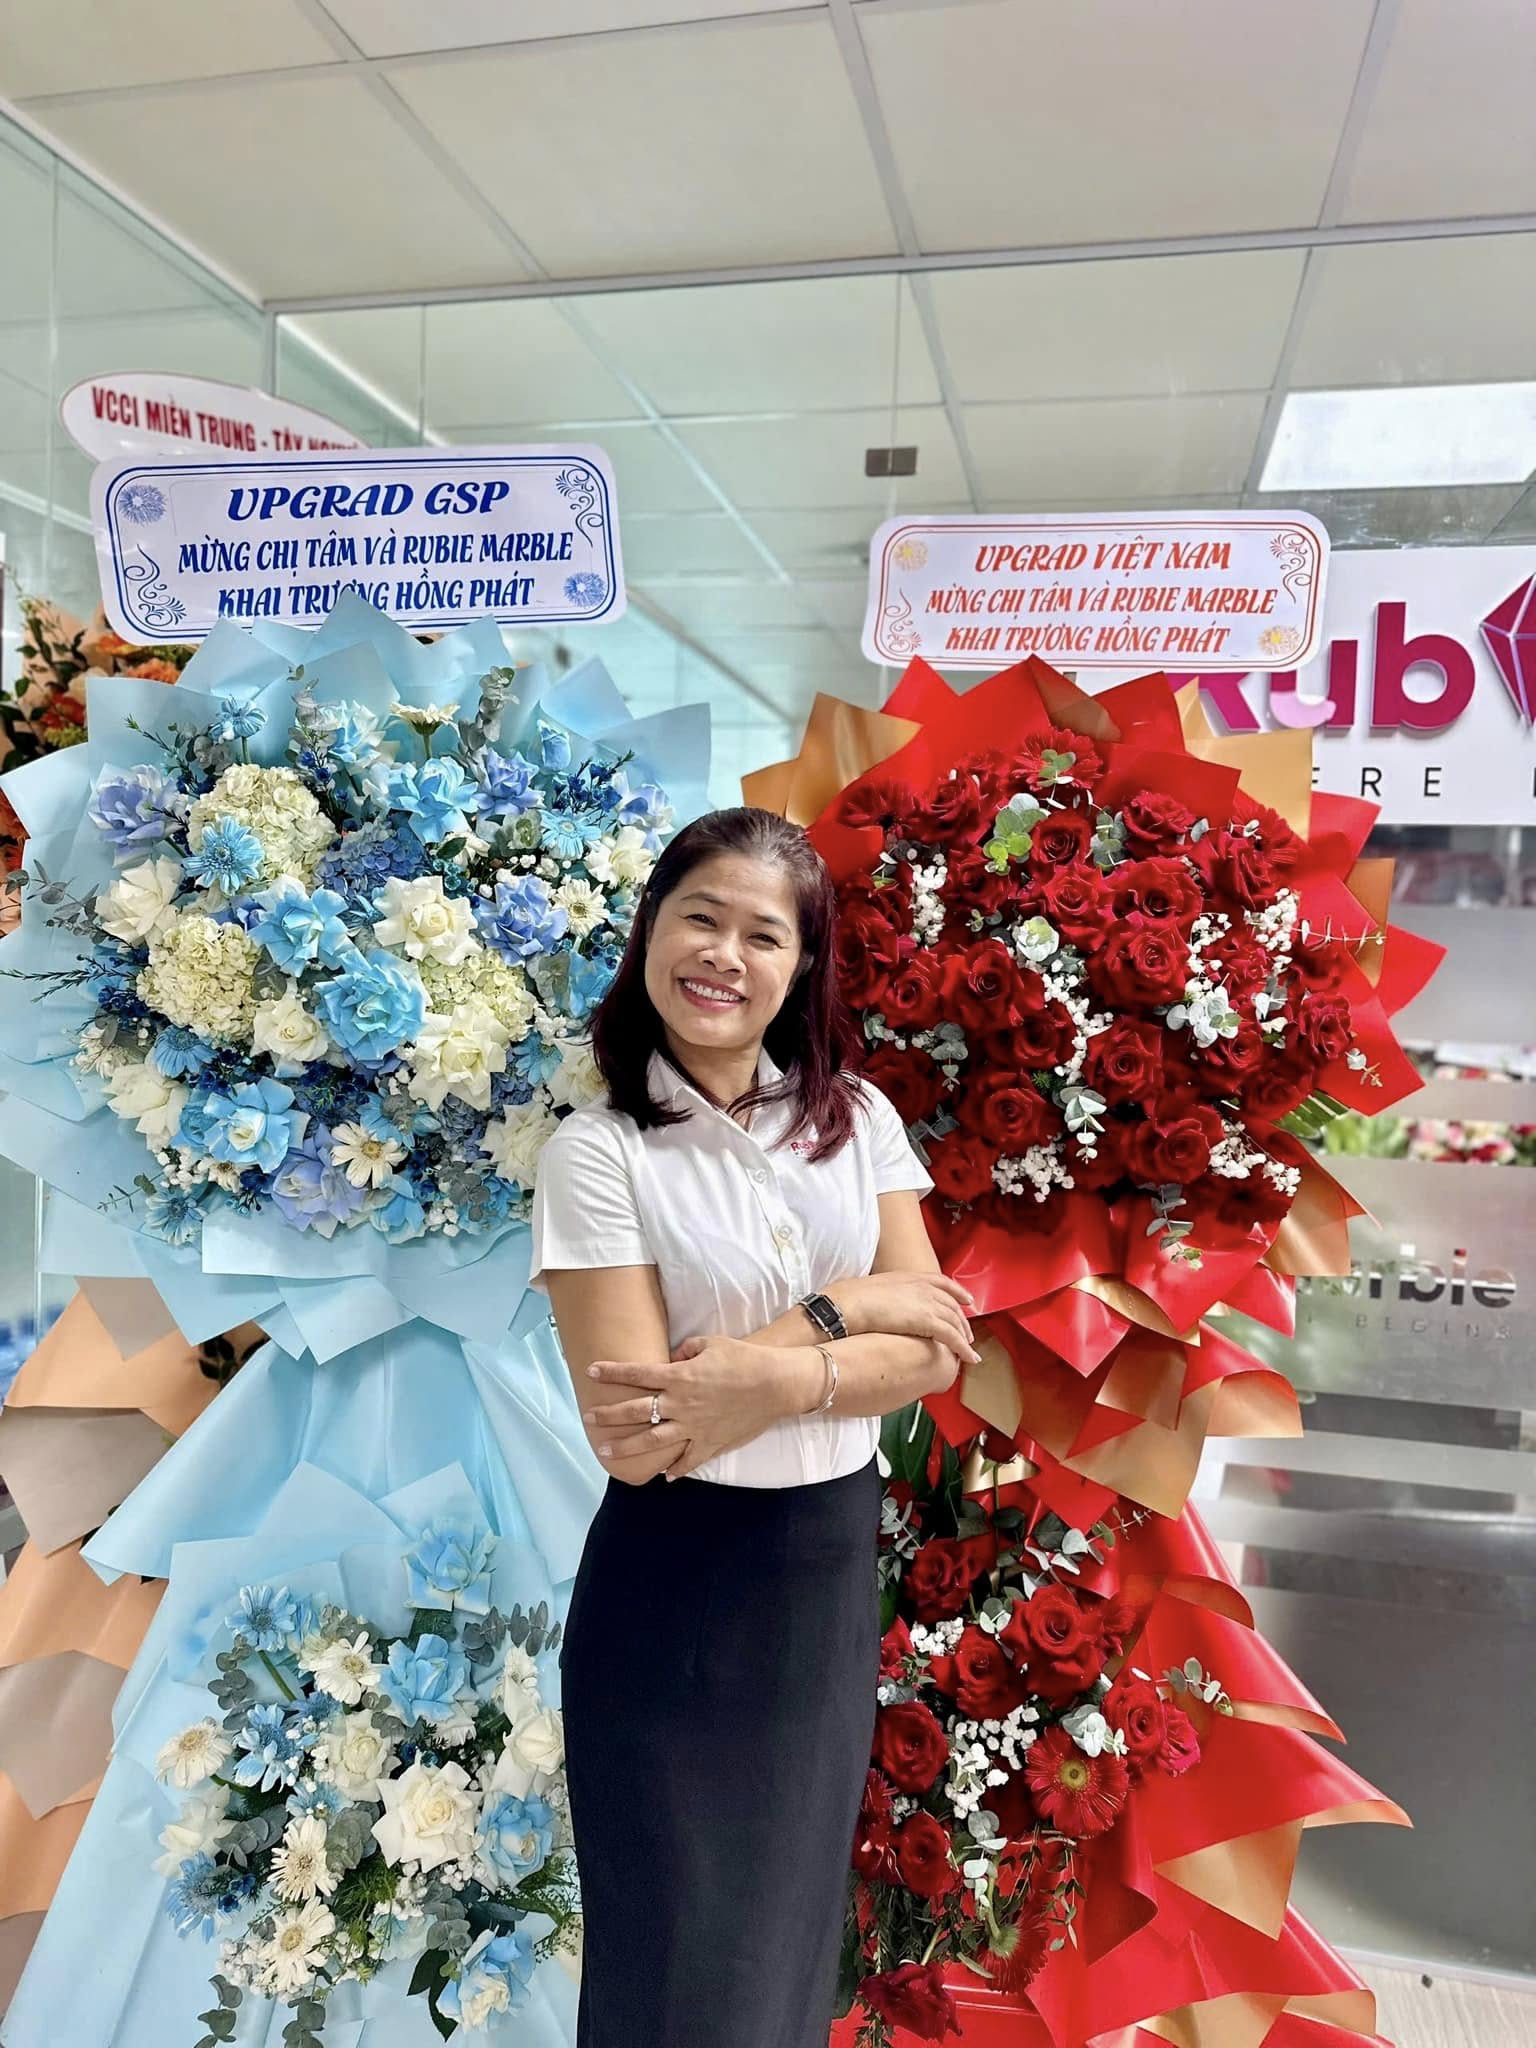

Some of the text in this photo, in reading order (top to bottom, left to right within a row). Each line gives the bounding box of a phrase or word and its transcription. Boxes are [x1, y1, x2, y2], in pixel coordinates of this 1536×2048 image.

[92, 386, 139, 427] VCCI
[196, 411, 257, 452] TRUNG
[227, 481, 510, 521] UPGRAD GSP
[178, 528, 573, 577] MỪNG CHỊ TÂM VÀ RUBIE MARBLE
[975, 536, 1233, 577] UPGRAD VIỆT NAM
[217, 586, 283, 619] KHAI
[395, 568, 465, 611] HỒNG
[469, 569, 536, 608] PHÁT
[925, 580, 1278, 619] MỪNG CHỊ TÂM VÀ RUBIE MARBLE
[945, 616, 1231, 654] KHAI TRƯƠNG HỒNG PHÁT
